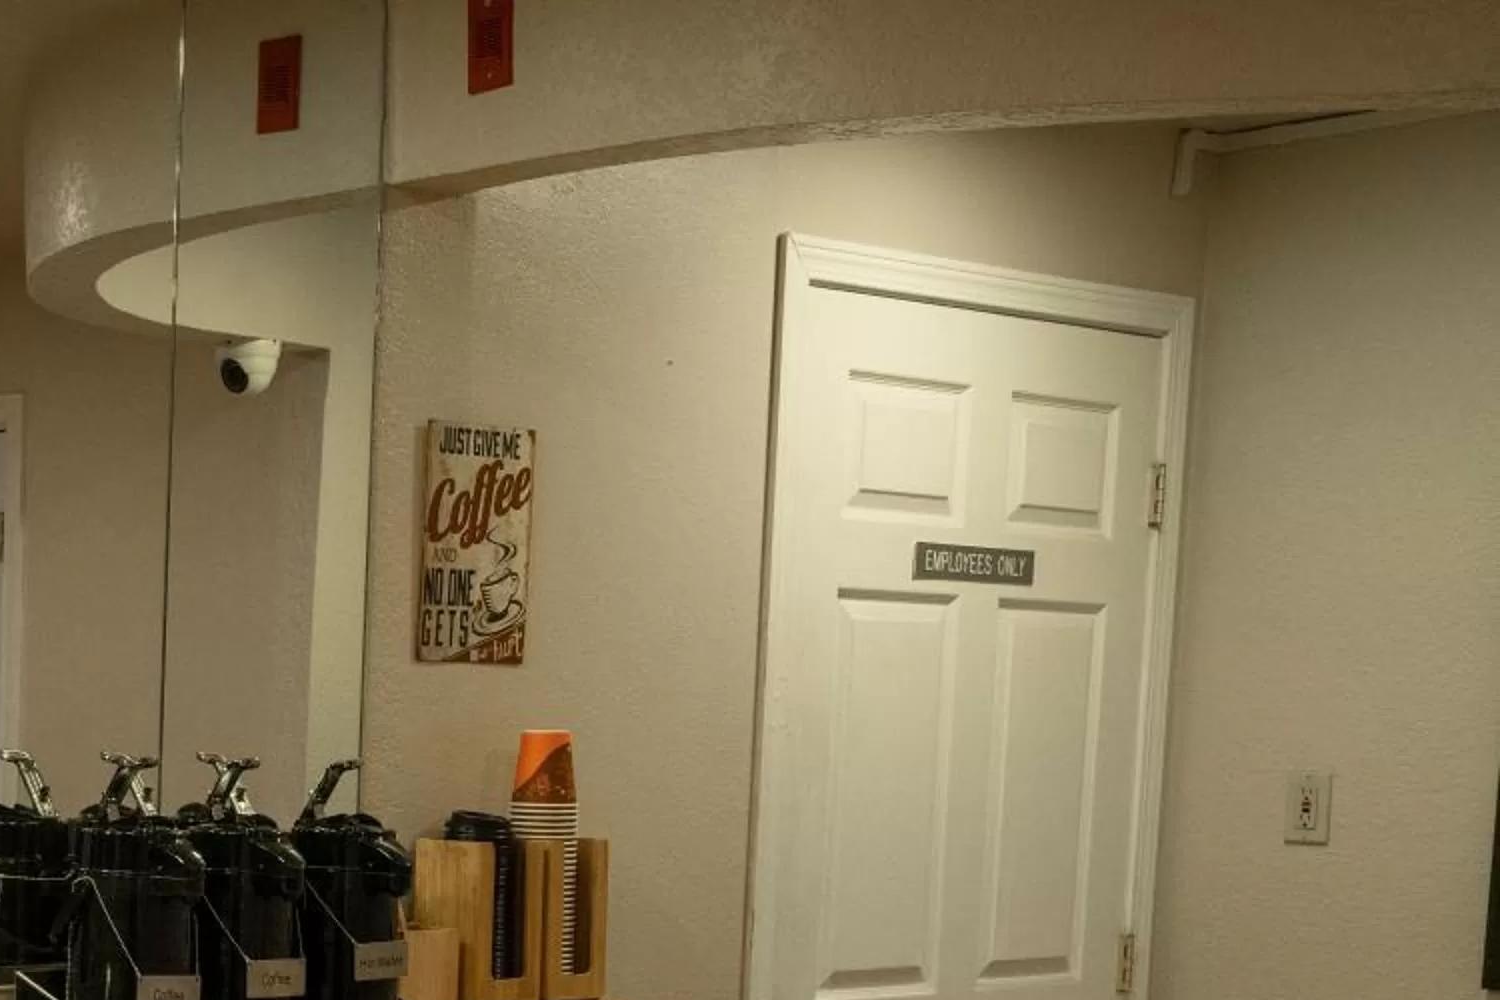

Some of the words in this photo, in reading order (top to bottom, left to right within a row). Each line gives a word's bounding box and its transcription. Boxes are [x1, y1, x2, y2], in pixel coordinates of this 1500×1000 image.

[439, 425, 472, 455] JUST
[473, 429, 500, 458] GIVE
[501, 431, 521, 460] ME
[427, 459, 532, 549] Coffee
[924, 549, 993, 575] EMPLOYEES
[997, 555, 1027, 577] ONLY
[424, 567, 443, 605] NO
[447, 569, 476, 607] ONE
[421, 608, 470, 648] GETS
